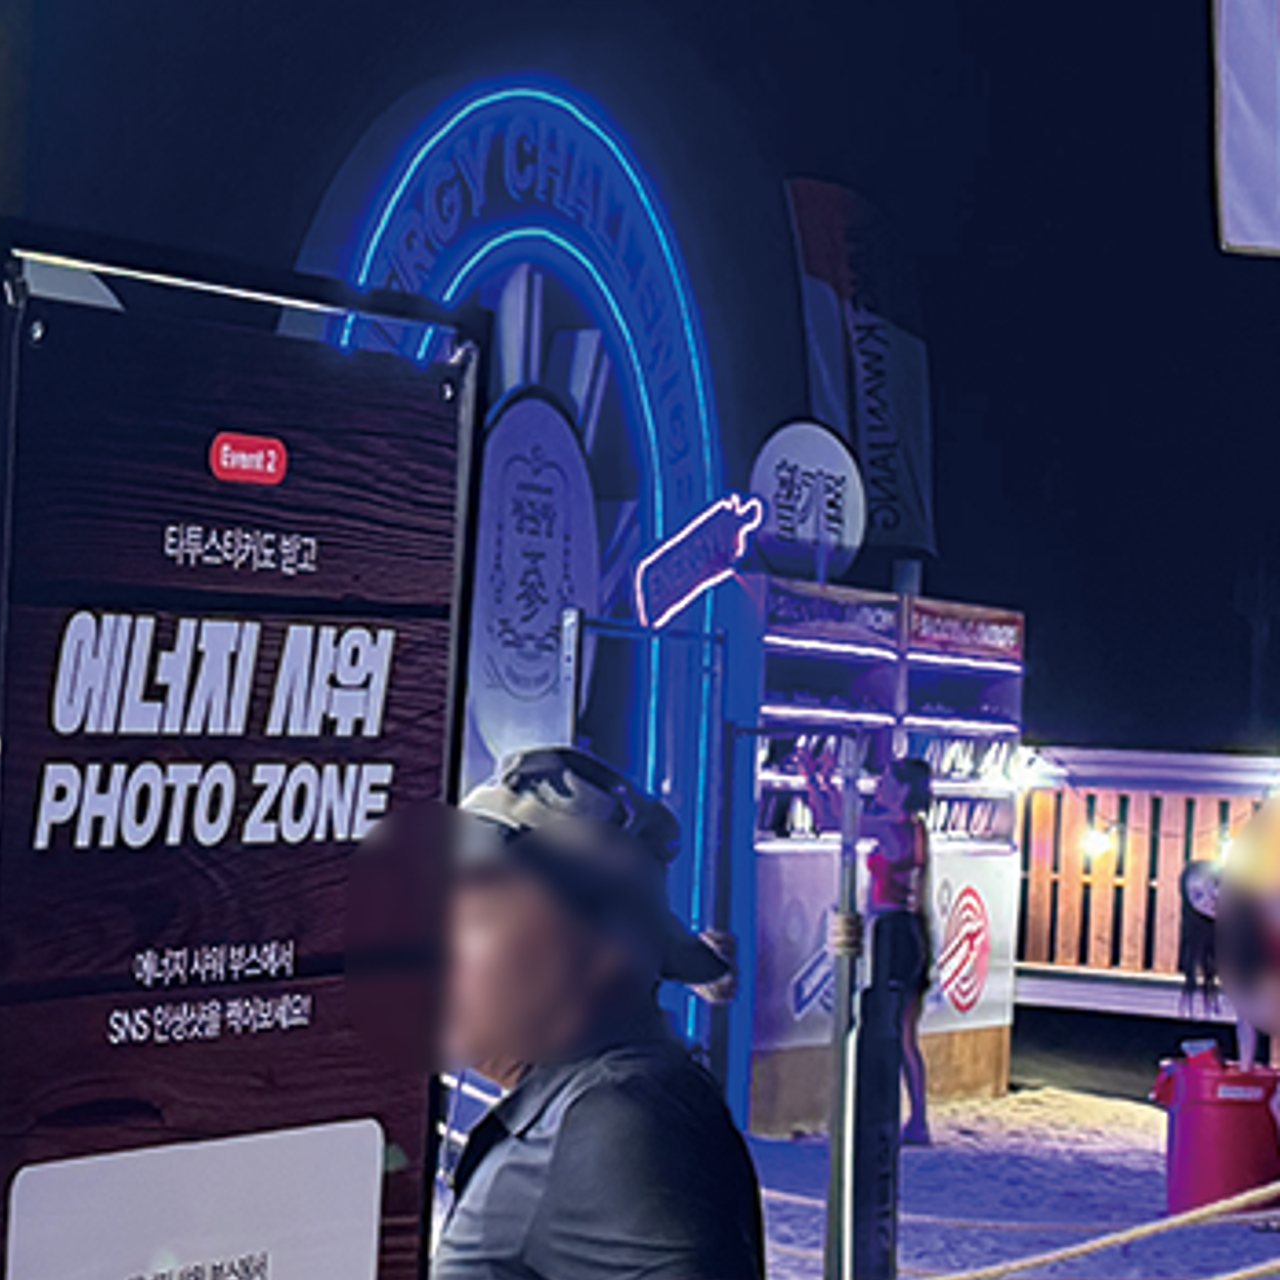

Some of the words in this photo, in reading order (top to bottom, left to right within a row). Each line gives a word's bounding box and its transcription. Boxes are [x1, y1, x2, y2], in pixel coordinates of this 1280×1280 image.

[220, 444, 264, 470] Event
[267, 451, 277, 473] 2
[164, 524, 276, 570] 타투스티커도
[53, 610, 260, 736] 에너지
[266, 623, 396, 738] 샤워
[33, 762, 236, 849] PHOTO
[241, 761, 393, 843] ZONE
[108, 1008, 151, 1045] SNS
